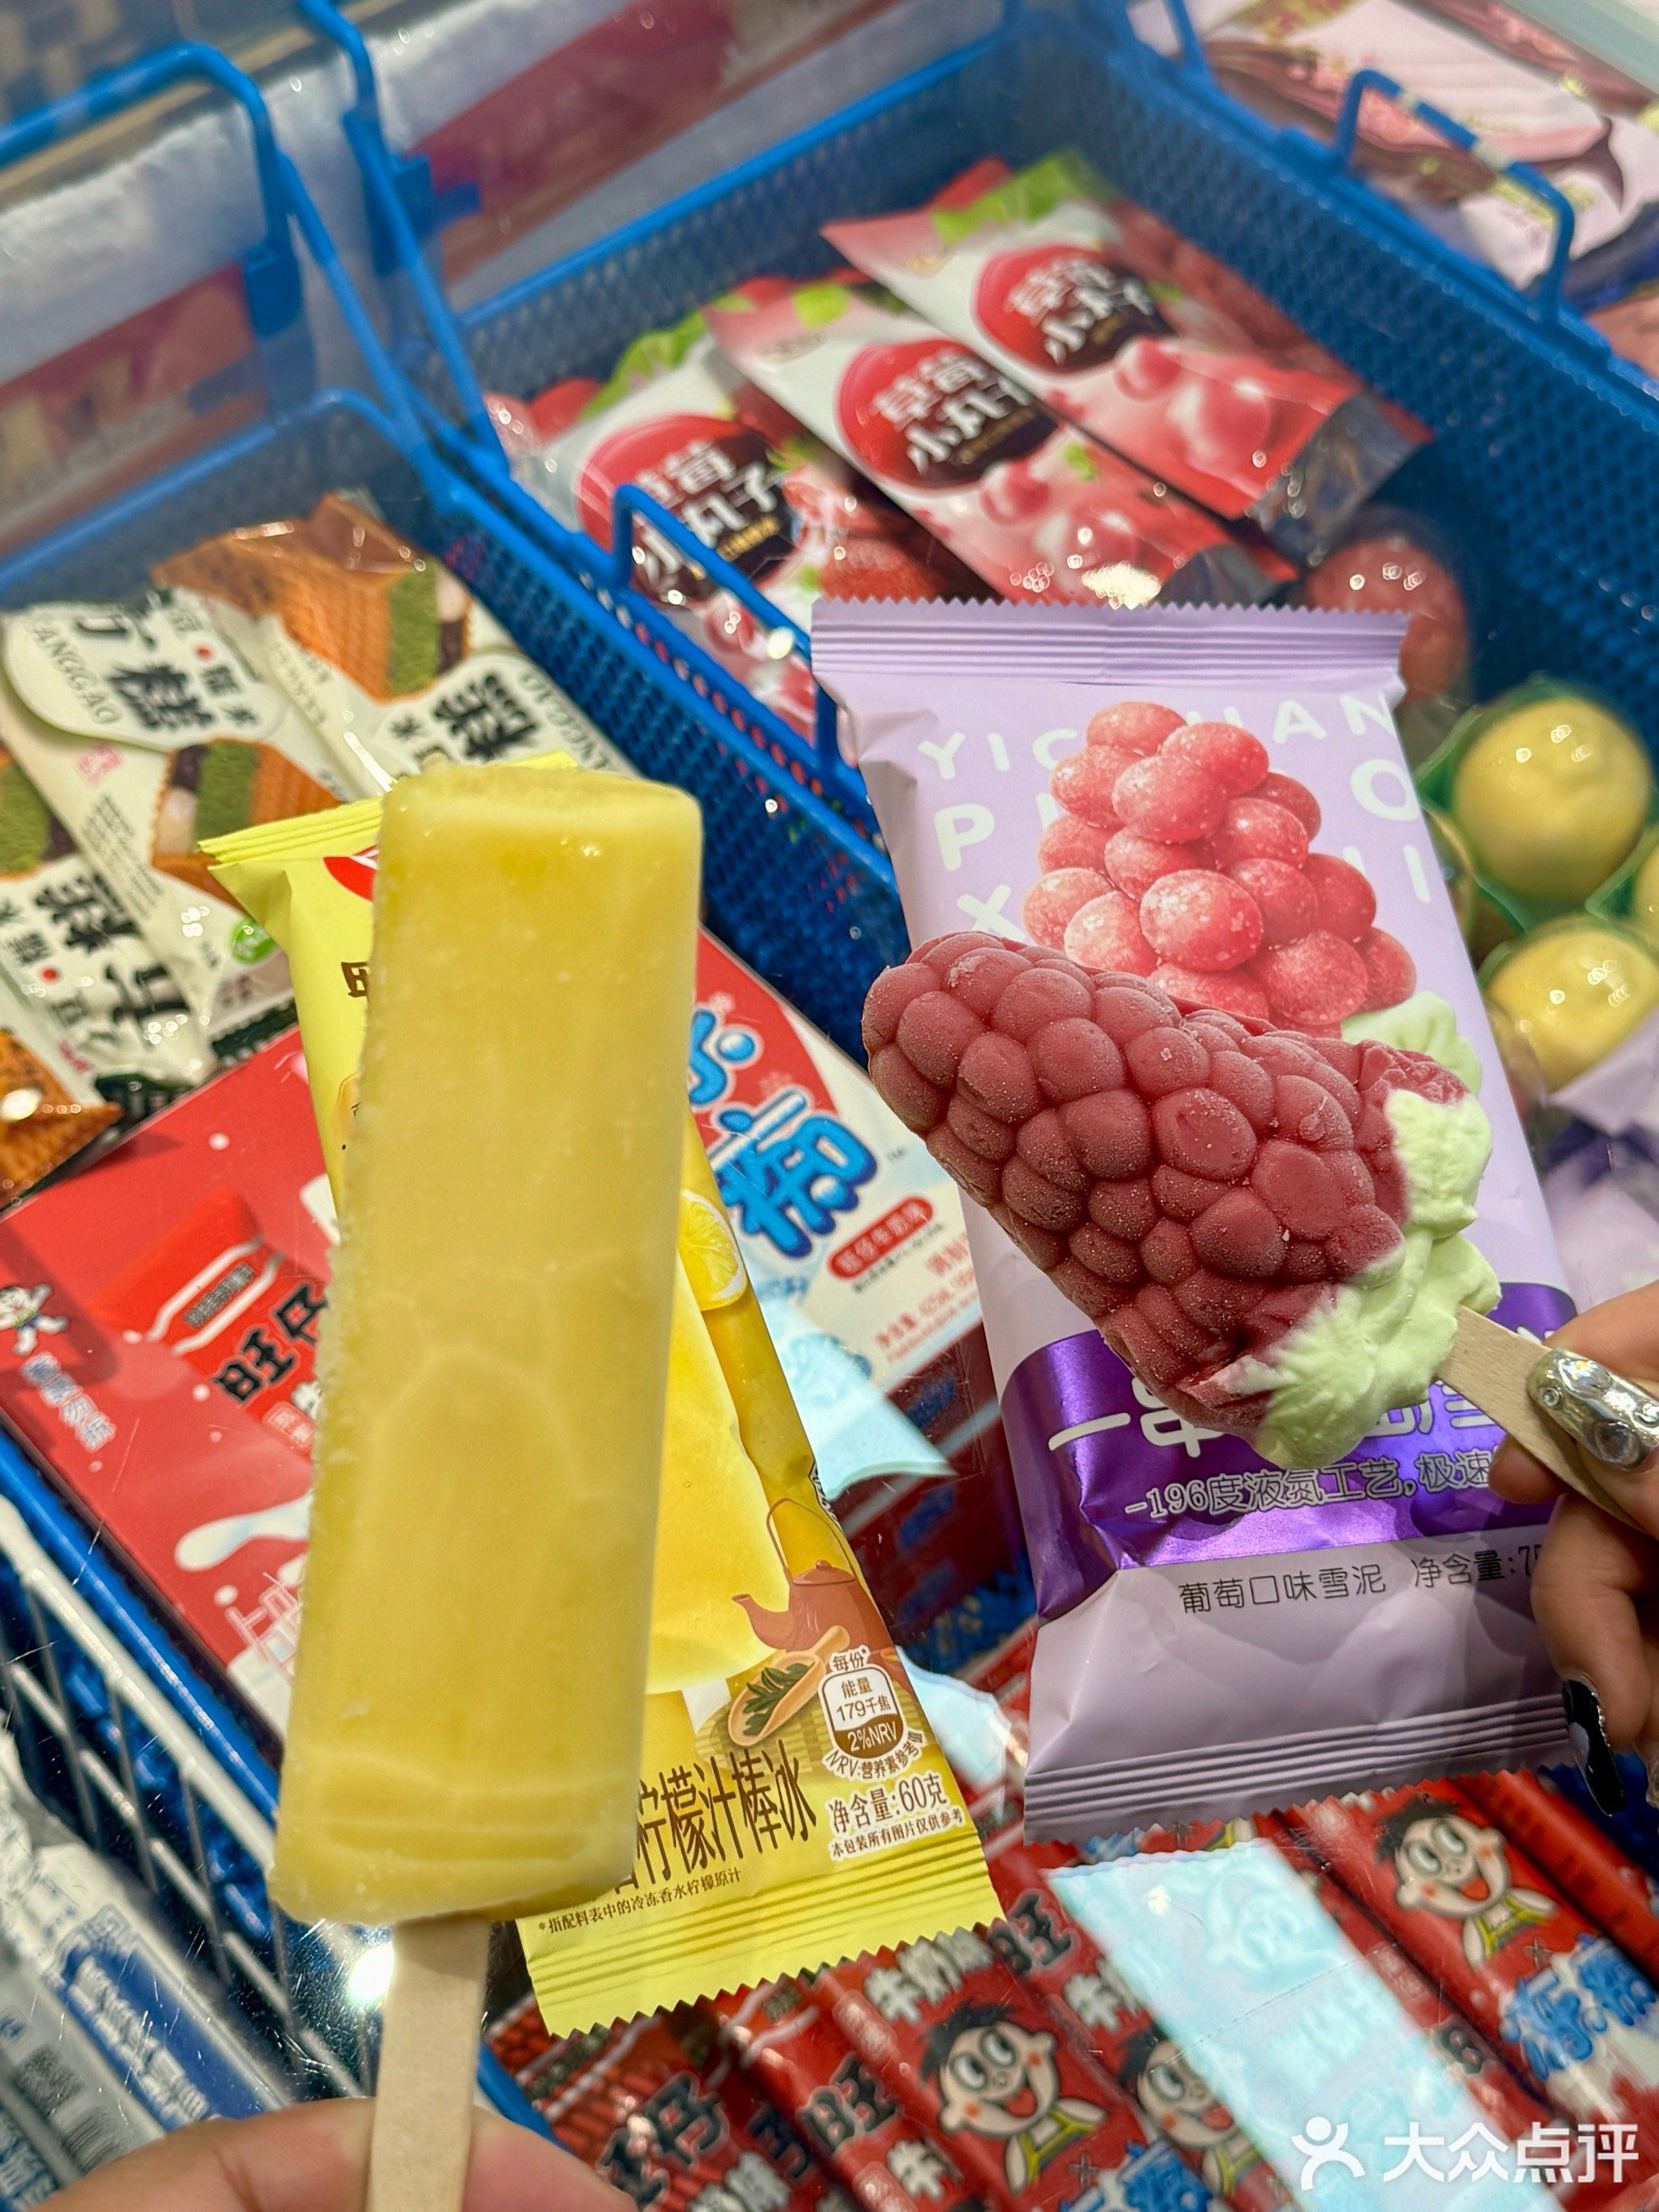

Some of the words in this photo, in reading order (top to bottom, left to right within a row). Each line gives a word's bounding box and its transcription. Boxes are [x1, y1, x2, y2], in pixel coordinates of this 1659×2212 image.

[1178, 1562, 1388, 1616] 葡萄口味雪泥
[837, 1695, 891, 1721] 179千焦
[841, 1676, 872, 1699] 能量
[847, 1723, 898, 1752] 2%NRV
[614, 1739, 817, 1894] 柠檬汁棒冰
[830, 1773, 948, 1833] 净含量:60克
[831, 1808, 963, 1858] 本包装所有图片仅供参考
